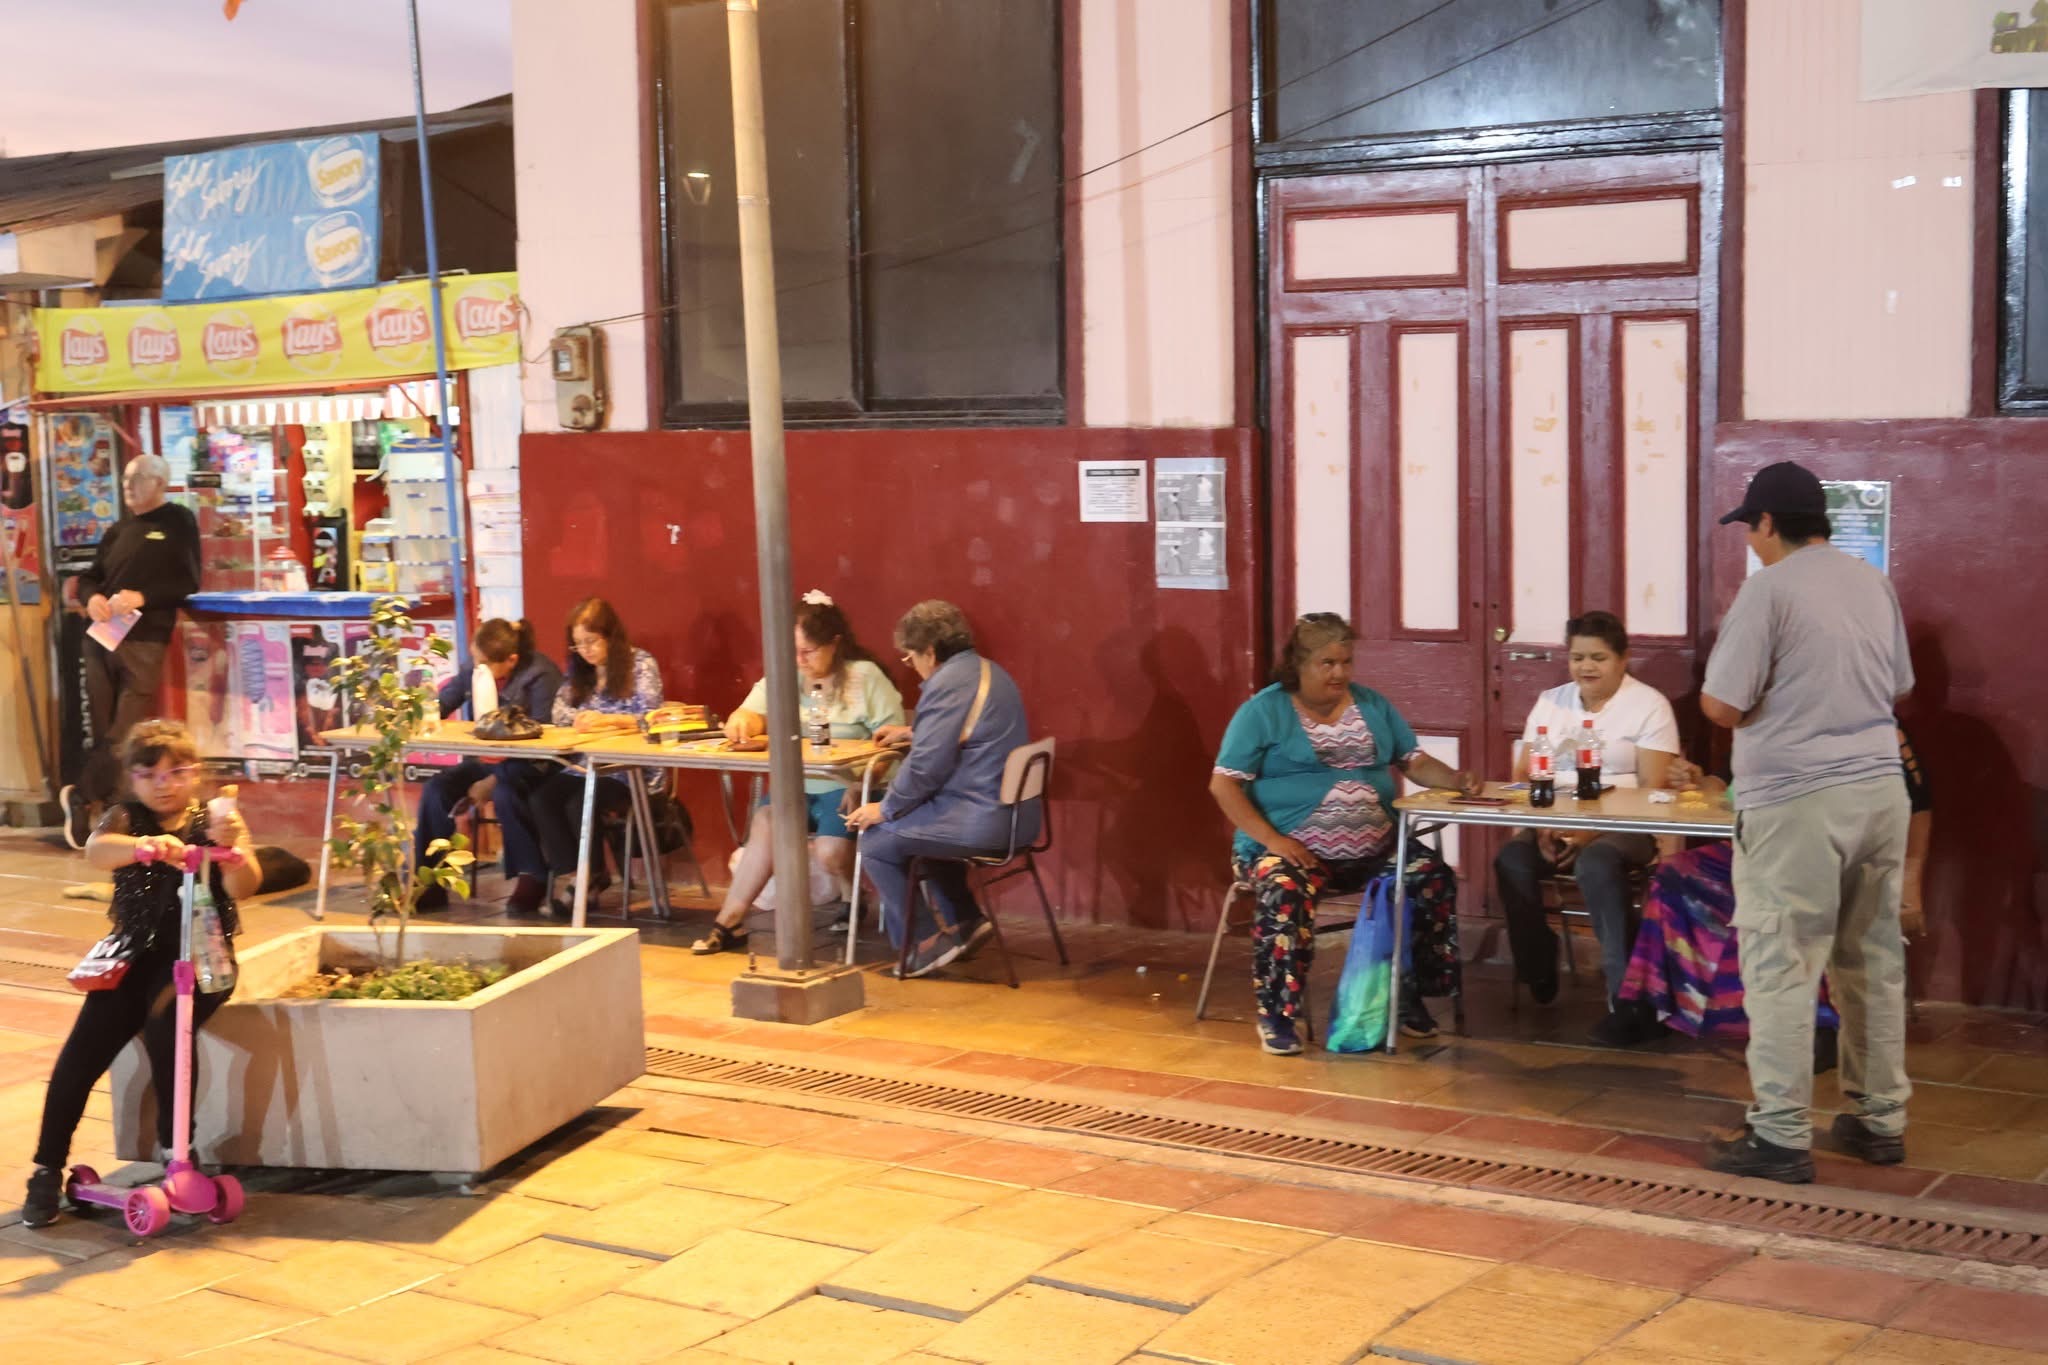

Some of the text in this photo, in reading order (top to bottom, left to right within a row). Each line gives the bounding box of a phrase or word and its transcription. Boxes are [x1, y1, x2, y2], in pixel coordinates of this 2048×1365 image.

[63, 297, 516, 366] Lay's Lay's Lay's Lay's Lay's Lay's
